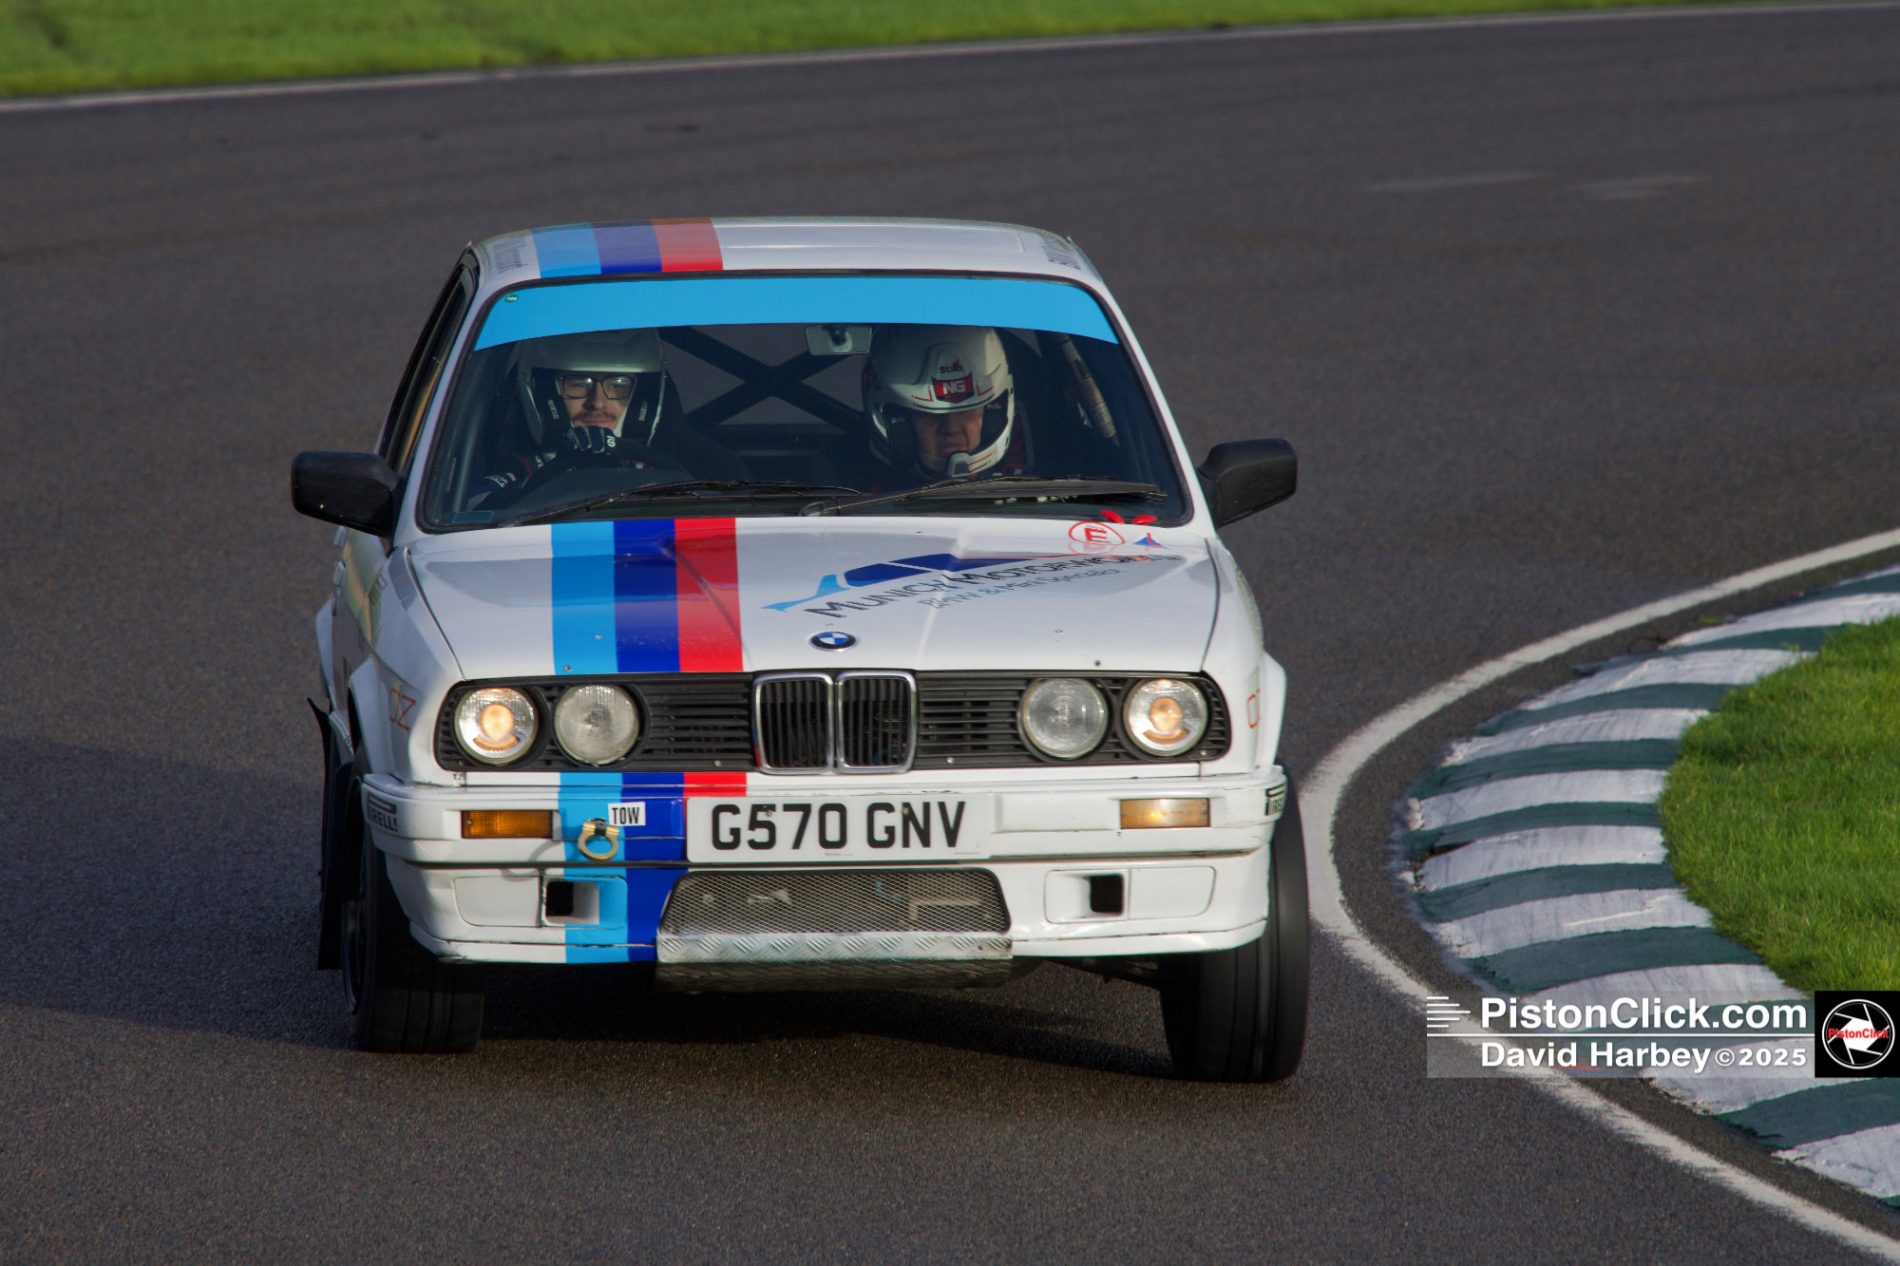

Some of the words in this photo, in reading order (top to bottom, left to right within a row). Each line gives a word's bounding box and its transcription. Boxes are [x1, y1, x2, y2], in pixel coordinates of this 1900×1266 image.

[1084, 527, 1108, 542] E
[803, 577, 948, 618] MUNICH
[611, 807, 640, 825] TOW
[711, 803, 848, 850] G570
[866, 801, 966, 849] GNV
